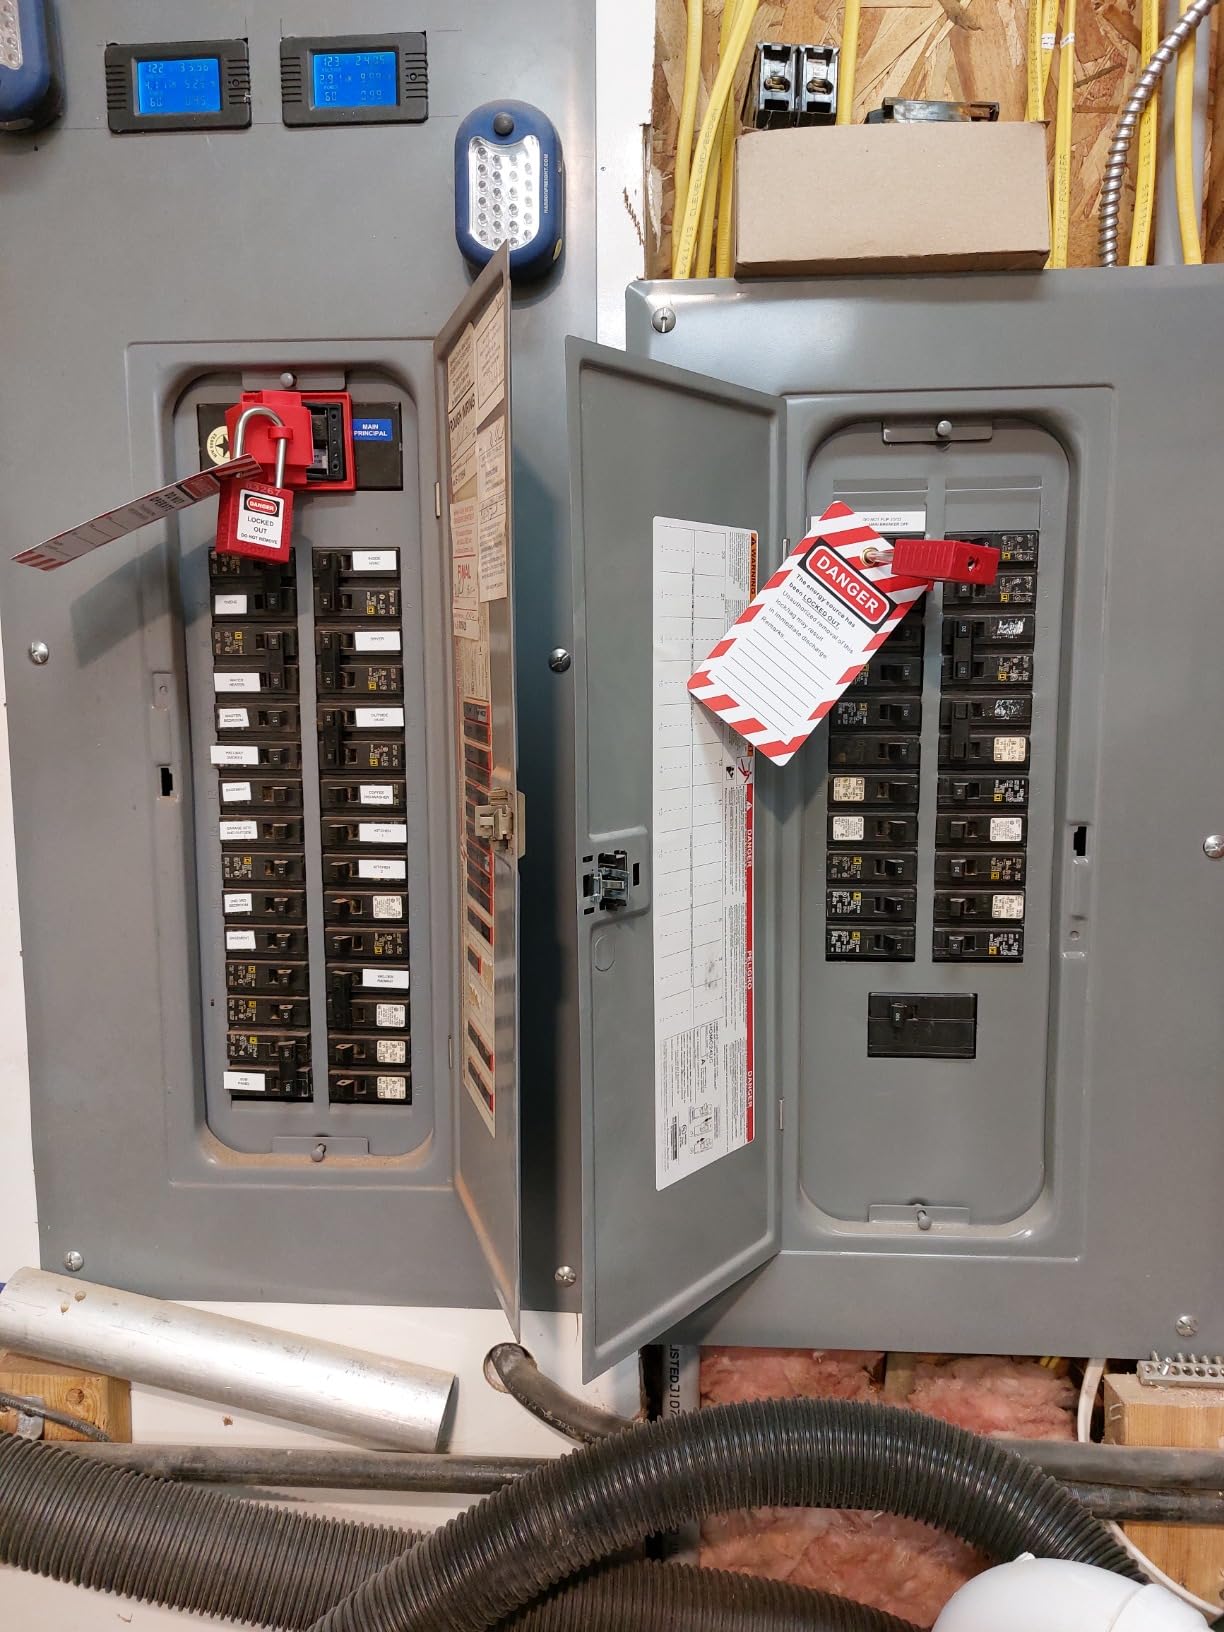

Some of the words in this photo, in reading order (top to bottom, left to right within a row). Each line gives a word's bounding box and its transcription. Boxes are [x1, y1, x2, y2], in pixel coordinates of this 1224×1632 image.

[324, 56, 340, 67] 123
[148, 63, 164, 73] 122
[325, 92, 337, 102] 60
[250, 501, 275, 512] DANGER
[248, 516, 274, 526] LOCKED
[254, 526, 268, 534] OUT
[259, 536, 278, 545] REMOVE
[816, 555, 879, 614] DANGER
[789, 582, 803, 596] been
[802, 594, 828, 617] LOCKED
[796, 574, 807, 585] The
[806, 583, 826, 602] energy
[826, 601, 845, 619] source
[845, 616, 856, 628] has
[774, 612, 802, 637] immediate
[775, 598, 797, 620] lock/tag
[796, 616, 808, 629] may
[807, 627, 824, 642] result
[782, 590, 818, 623] Unauthorized
[817, 620, 838, 640] removal
[843, 643, 854, 654] this
